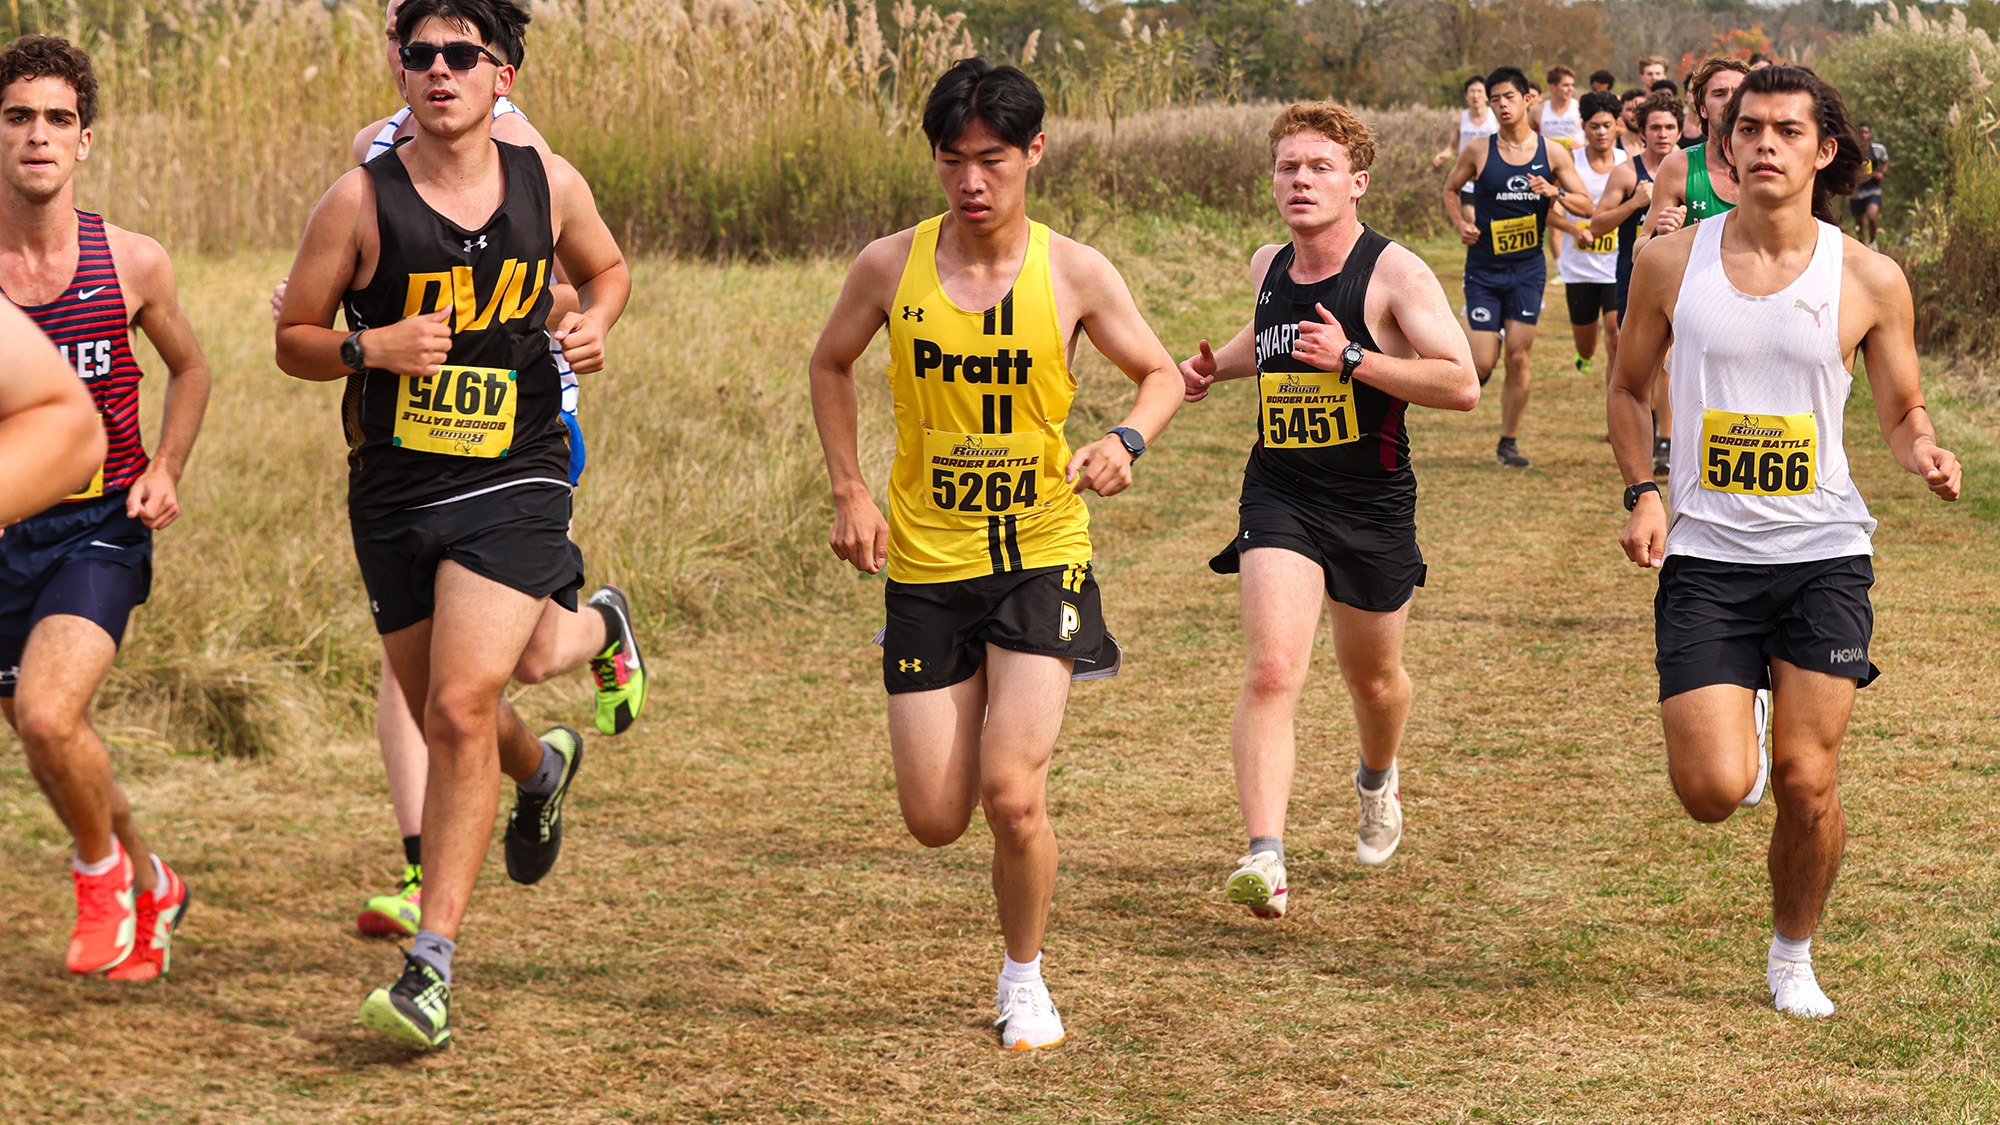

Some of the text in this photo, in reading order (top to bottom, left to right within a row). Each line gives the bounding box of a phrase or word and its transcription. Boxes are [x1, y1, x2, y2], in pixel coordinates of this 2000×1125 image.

[1495, 192, 1541, 201] ABINGTON
[1498, 230, 1535, 252] 5270
[1578, 236, 1613, 251] 470
[402, 258, 547, 334] DVU
[1255, 323, 1300, 366] SWART
[913, 339, 1033, 385] Pratt
[408, 369, 508, 416] 4975
[1278, 384, 1320, 394] Rowan
[1266, 394, 1347, 404] BORDER BATTLE
[401, 411, 507, 431] BORDER BATTLE
[1269, 406, 1349, 445] 5451
[430, 428, 485, 444] Rowan
[1730, 425, 1783, 437] Rowan
[1710, 435, 1811, 449] BORDER BATTLE
[951, 446, 1009, 457] Rowan
[931, 456, 1039, 468] BORDER BATTLE
[1708, 447, 1810, 492] 5466
[932, 468, 1038, 512] 5264
[1058, 600, 1080, 641] P
[1830, 647, 1864, 664] HOKA
